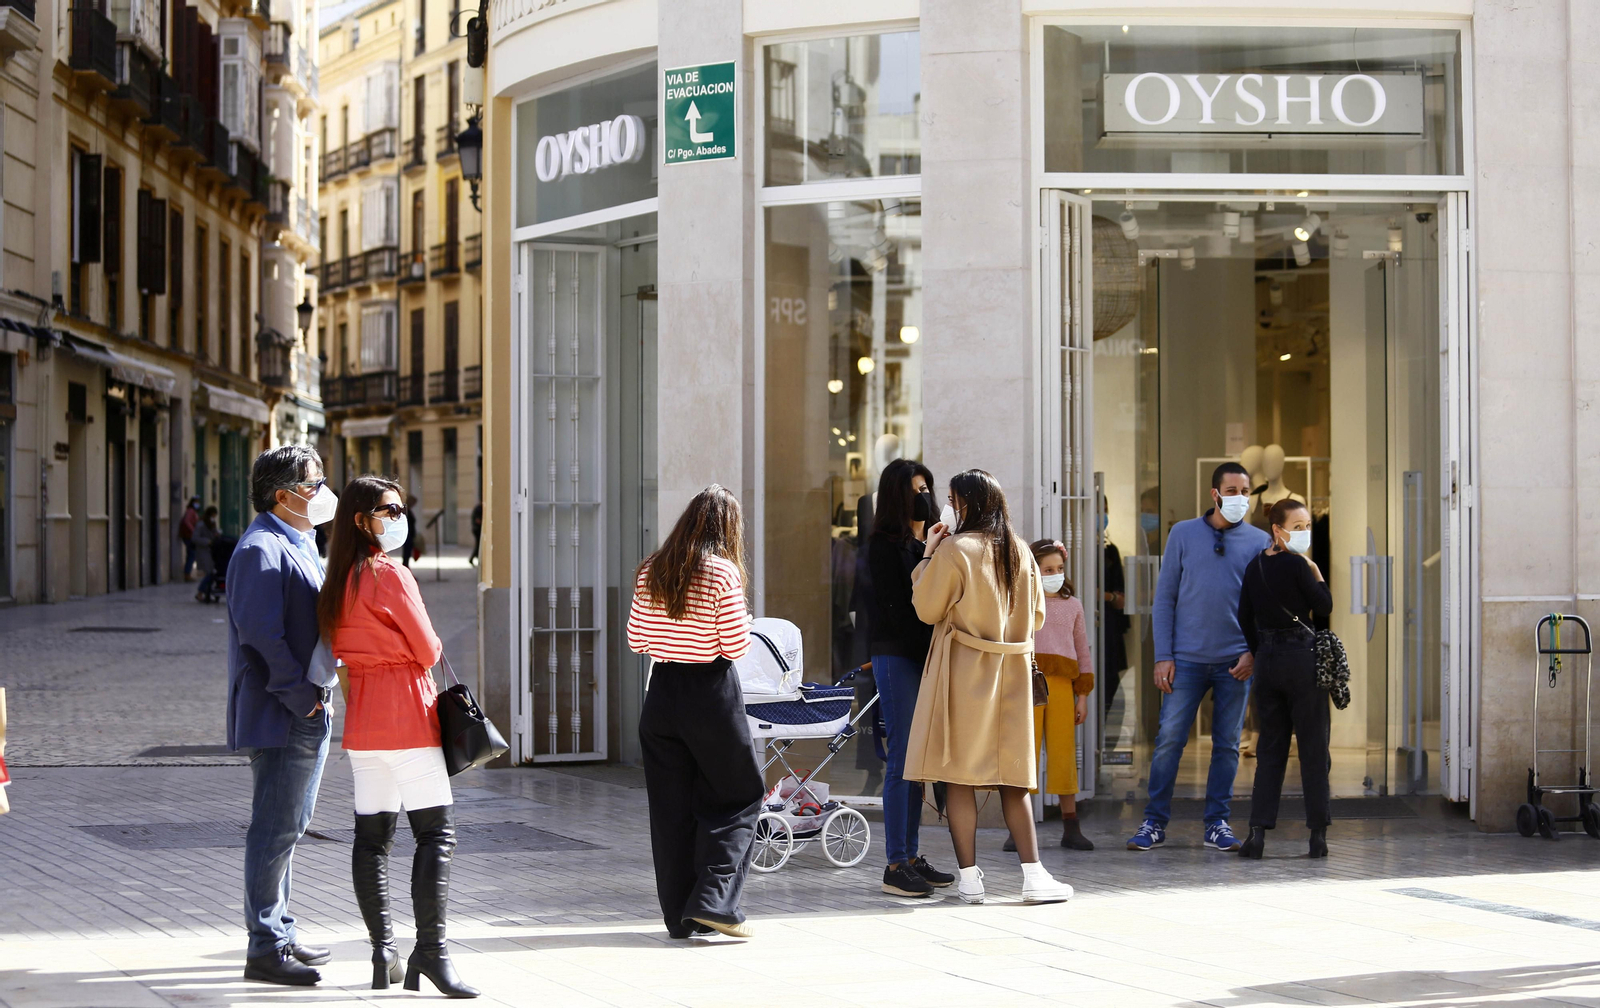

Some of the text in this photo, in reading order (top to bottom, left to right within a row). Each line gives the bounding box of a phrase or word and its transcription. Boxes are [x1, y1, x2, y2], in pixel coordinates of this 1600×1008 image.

[667, 71, 699, 86] VIA DE
[666, 82, 734, 100] EVACUACION
[1124, 72, 1387, 127] OYSHO
[535, 114, 642, 182] OYSHO
[667, 145, 726, 160] C/ Pgo. Abades
[1150, 831, 1160, 842] N
[1210, 831, 1219, 843] N
